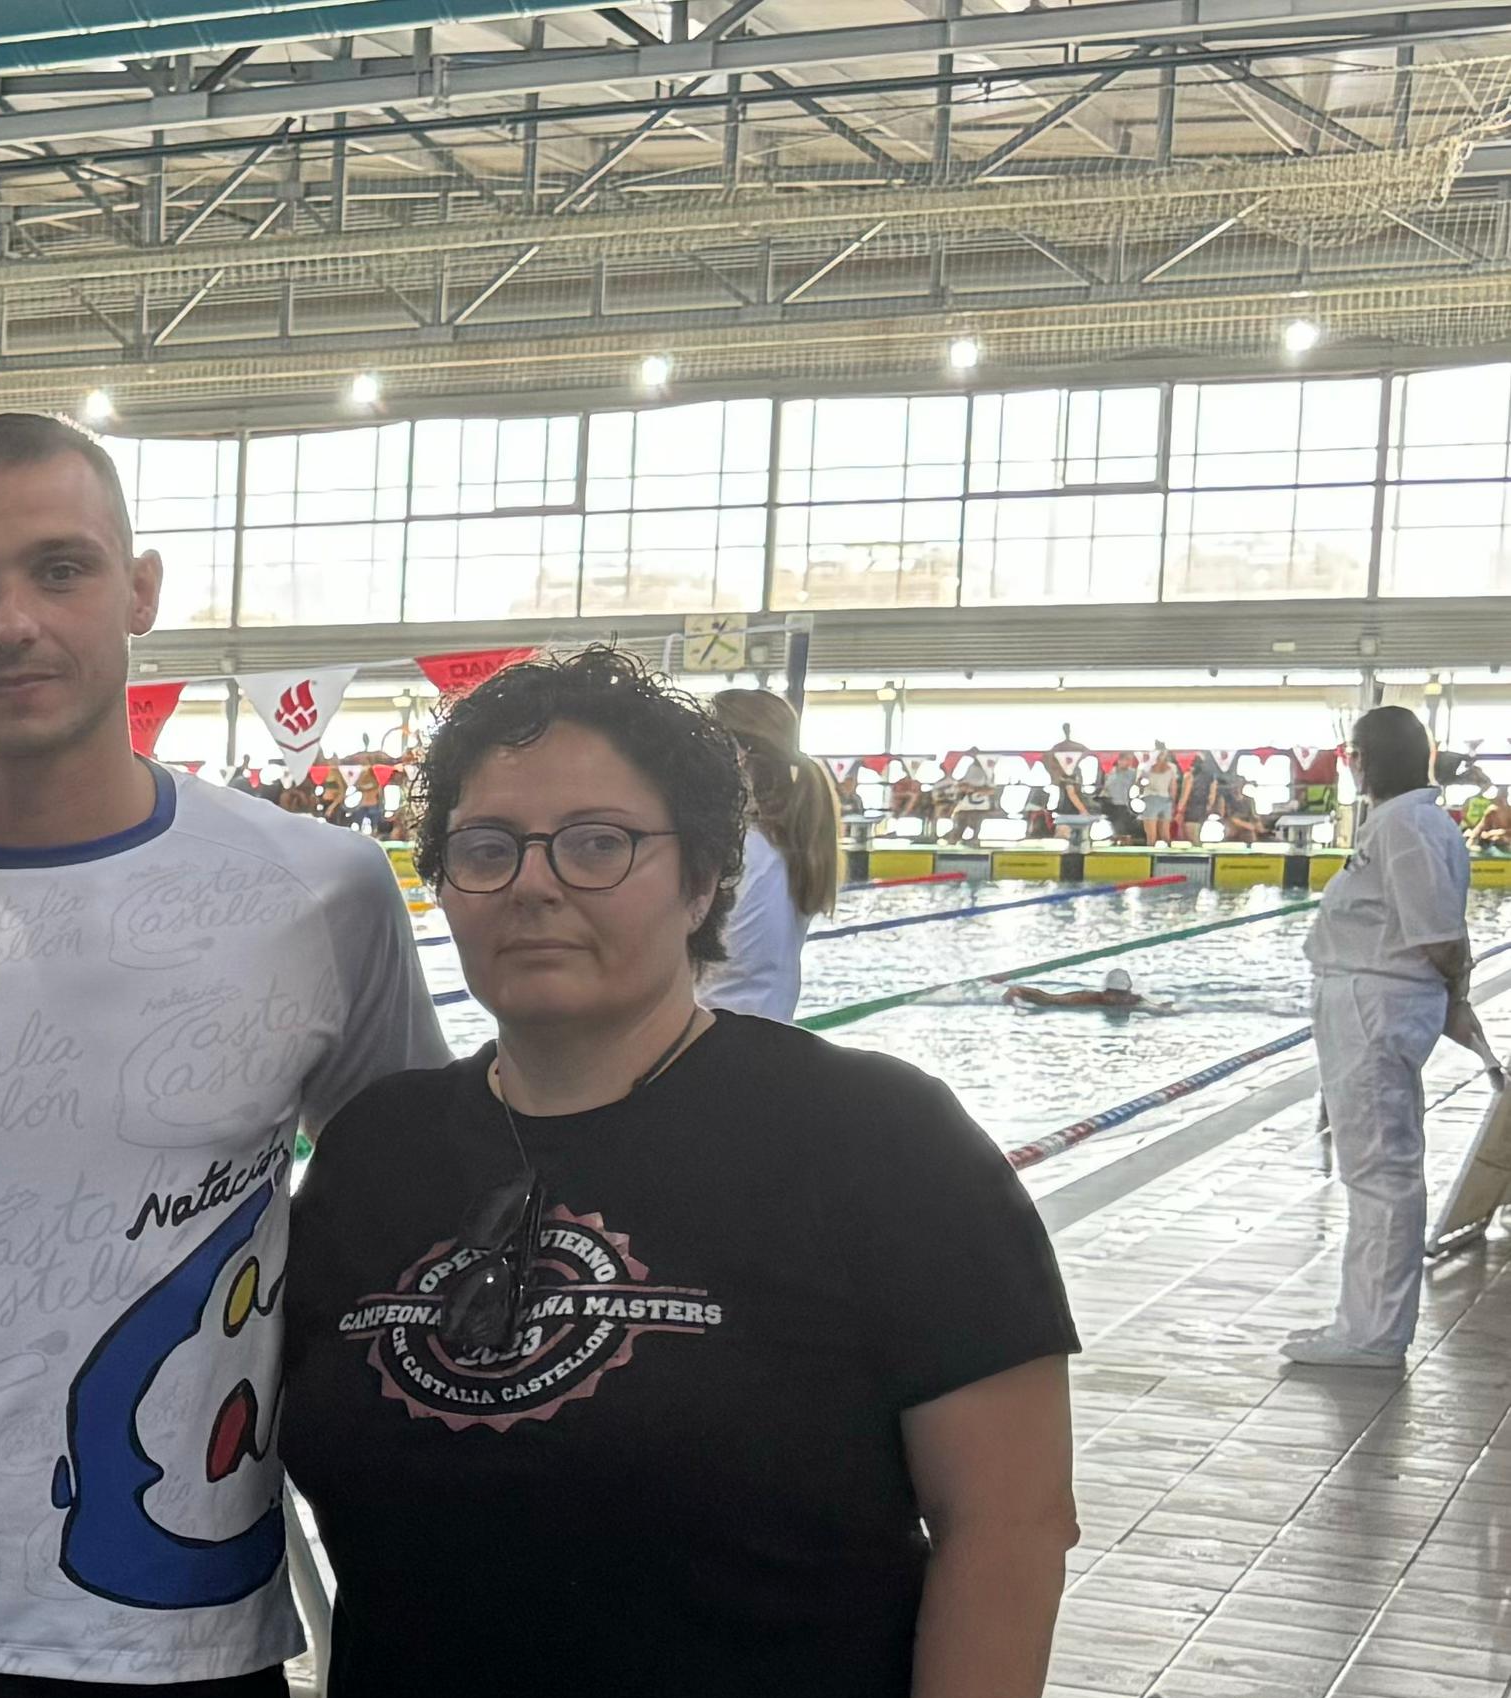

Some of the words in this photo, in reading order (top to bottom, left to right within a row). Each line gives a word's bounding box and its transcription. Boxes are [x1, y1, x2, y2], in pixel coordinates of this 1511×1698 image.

[125, 1130, 288, 1243] Natación
[582, 1296, 723, 1325] MASTERS
[392, 1326, 409, 1357] CN
[401, 1355, 496, 1405] CASTALIA
[500, 1319, 616, 1402] CASTELLON
